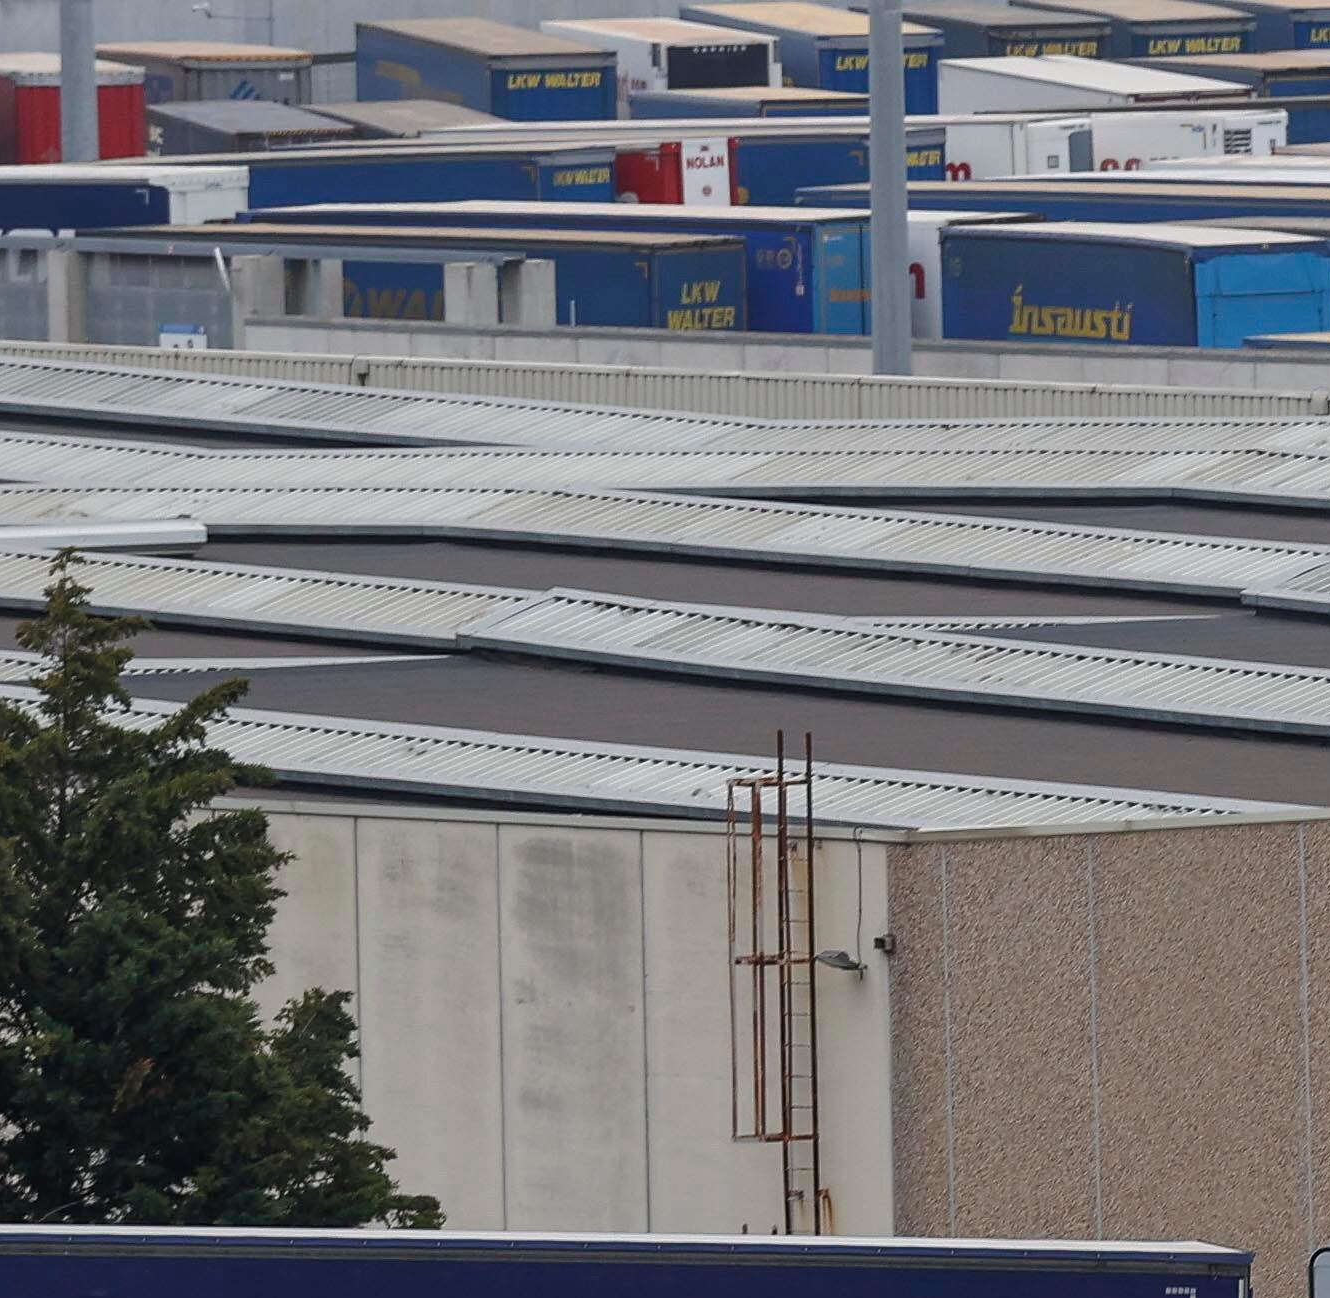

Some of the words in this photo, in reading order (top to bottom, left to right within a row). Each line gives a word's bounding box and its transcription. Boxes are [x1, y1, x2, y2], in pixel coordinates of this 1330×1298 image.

[1148, 38, 1182, 56] LKW
[1186, 36, 1242, 54] WALTER
[507, 72, 541, 90] LKW
[545, 71, 602, 90] WALTER
[685, 155, 725, 170] NOLAN
[680, 280, 721, 304] LKW
[667, 306, 735, 331] WALTER
[203, 349, 719, 453] GEFCO
